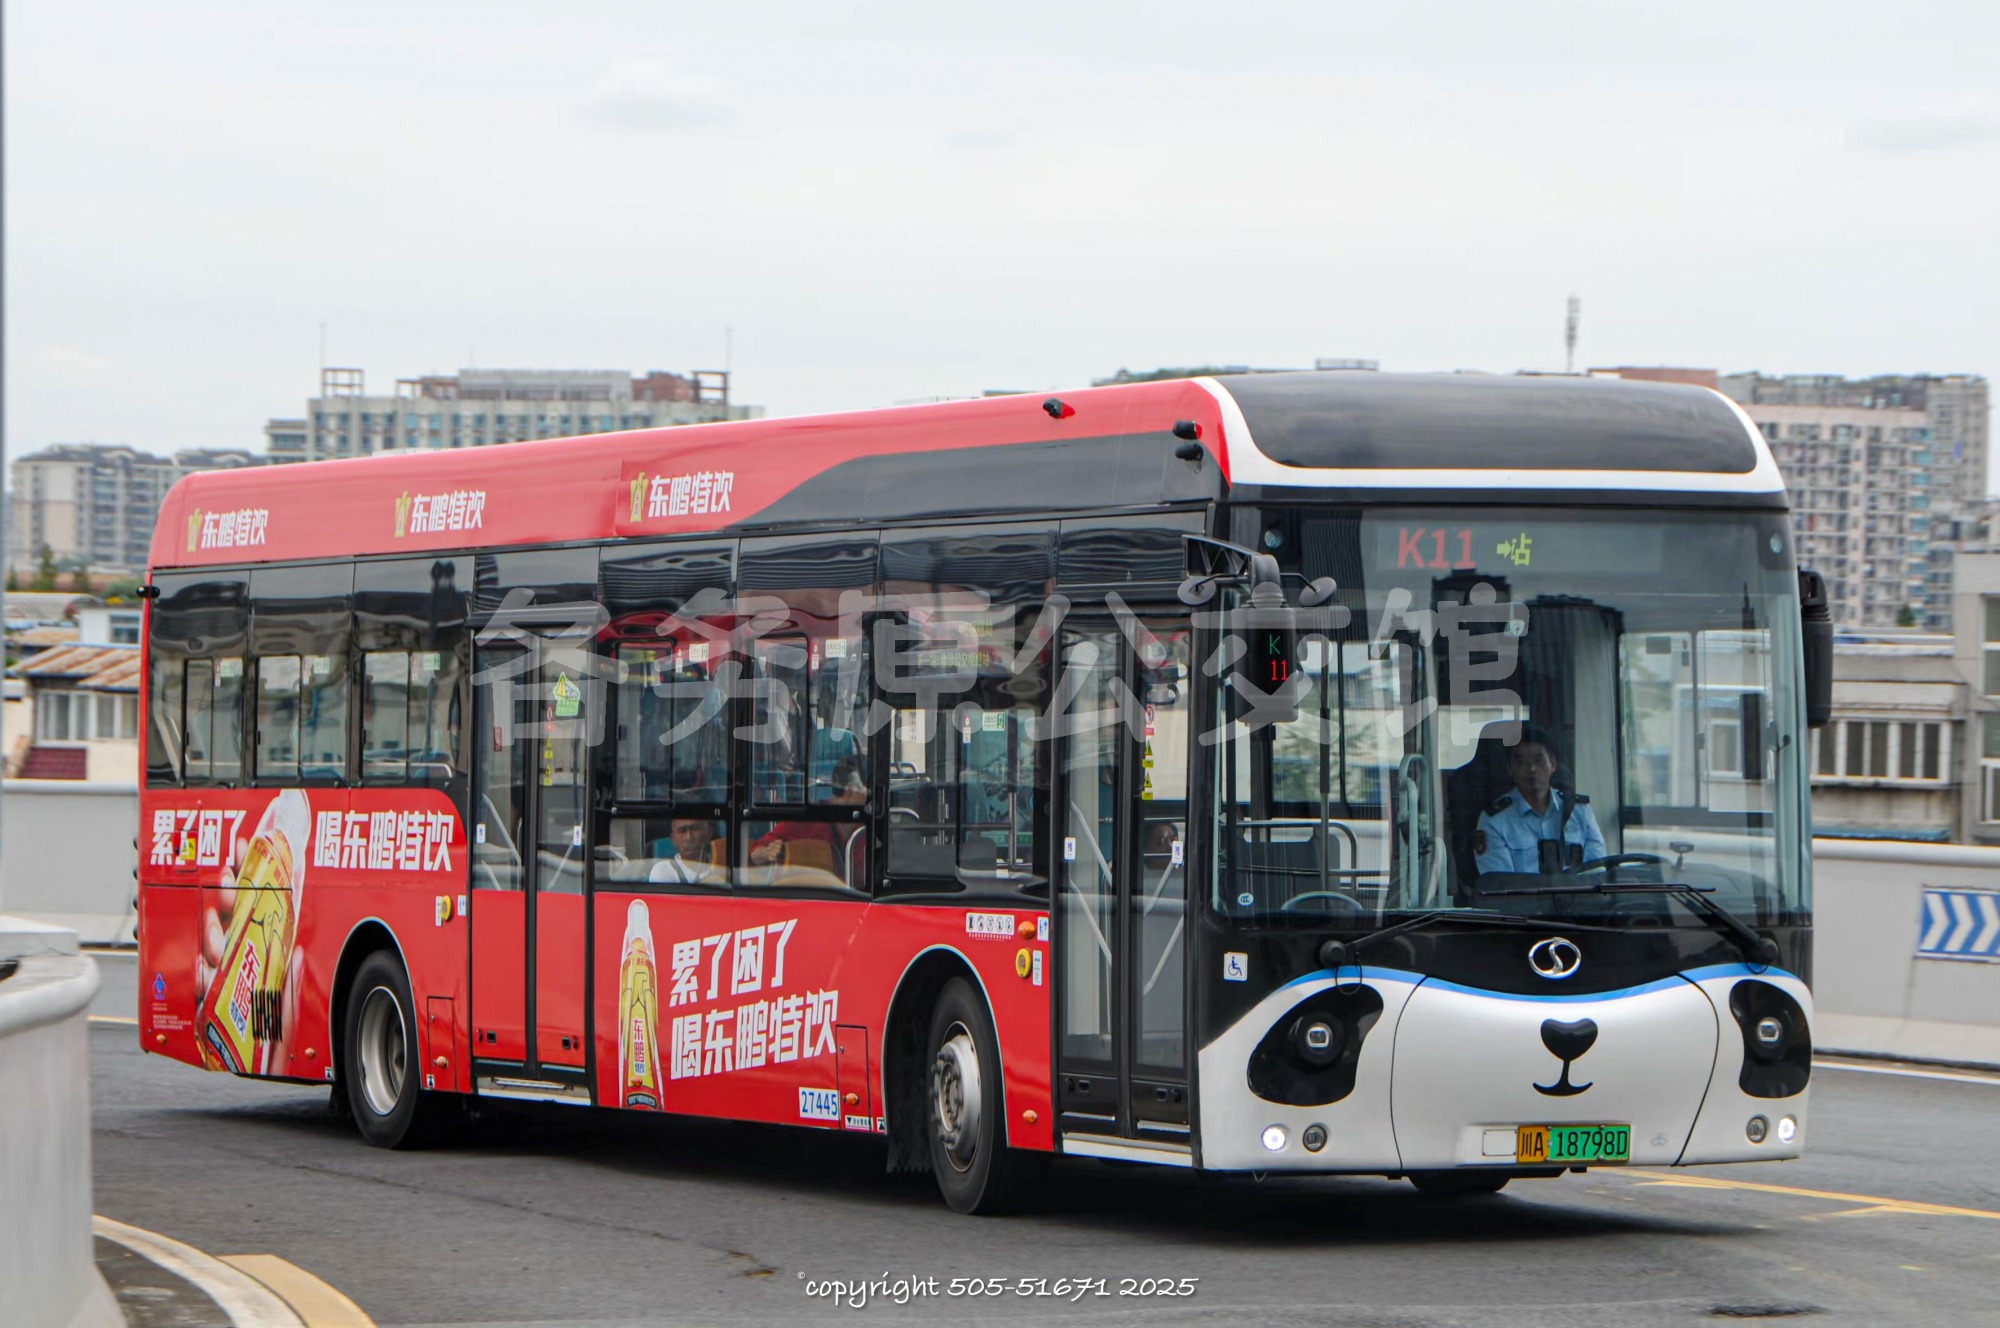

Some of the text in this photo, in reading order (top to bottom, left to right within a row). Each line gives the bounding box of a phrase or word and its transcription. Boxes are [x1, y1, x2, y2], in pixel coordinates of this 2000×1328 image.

[410, 490, 486, 533] 东鹏特饮
[648, 470, 734, 517] 东鹏特饮
[201, 508, 269, 549] 东鹏特饮
[1398, 528, 1477, 568] K11
[1269, 634, 1281, 654] K
[1271, 659, 1289, 681] 11
[150, 810, 247, 866] 累了困了
[314, 809, 455, 872] 喝东鹏特饮
[669, 918, 798, 1008] 累了困了
[671, 988, 839, 1080] 喝东鹏特饮
[801, 1091, 838, 1116] 27445
[1520, 1130, 1628, 1157] 川A 18798D
